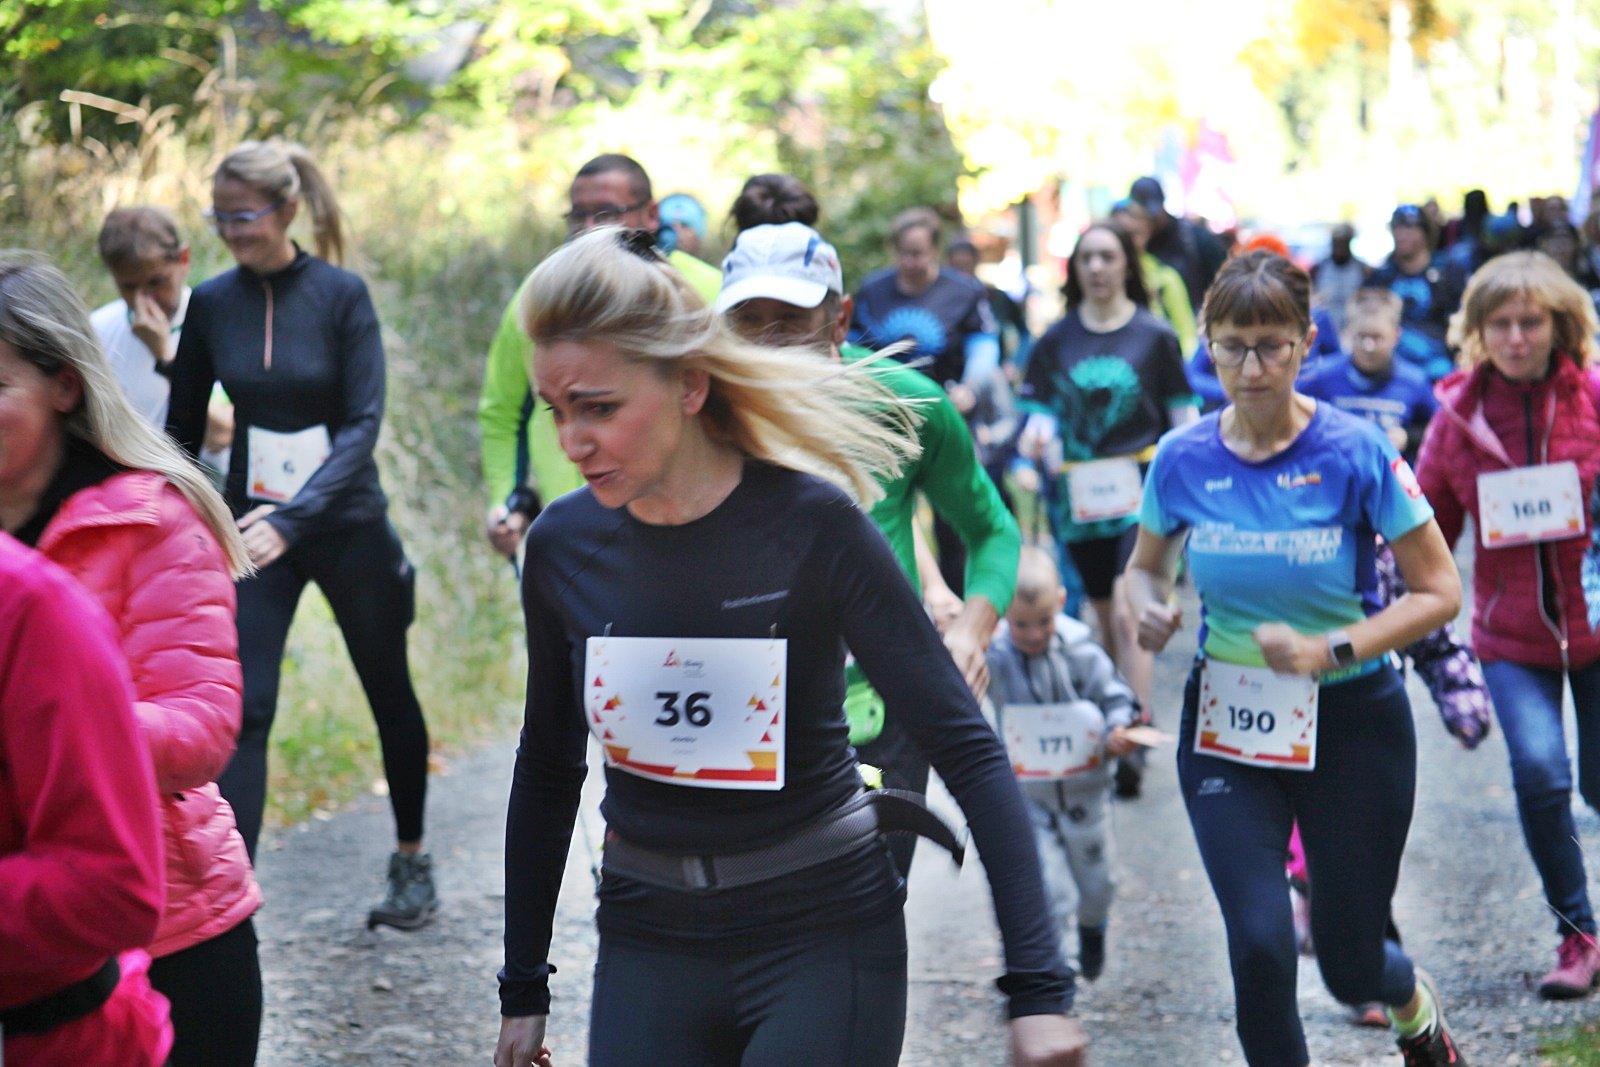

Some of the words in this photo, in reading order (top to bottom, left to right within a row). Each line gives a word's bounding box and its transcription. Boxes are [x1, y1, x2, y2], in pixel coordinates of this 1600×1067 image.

[282, 460, 295, 474] 6
[655, 692, 713, 727] 36
[1228, 705, 1276, 734] 190
[1039, 735, 1073, 754] 171
